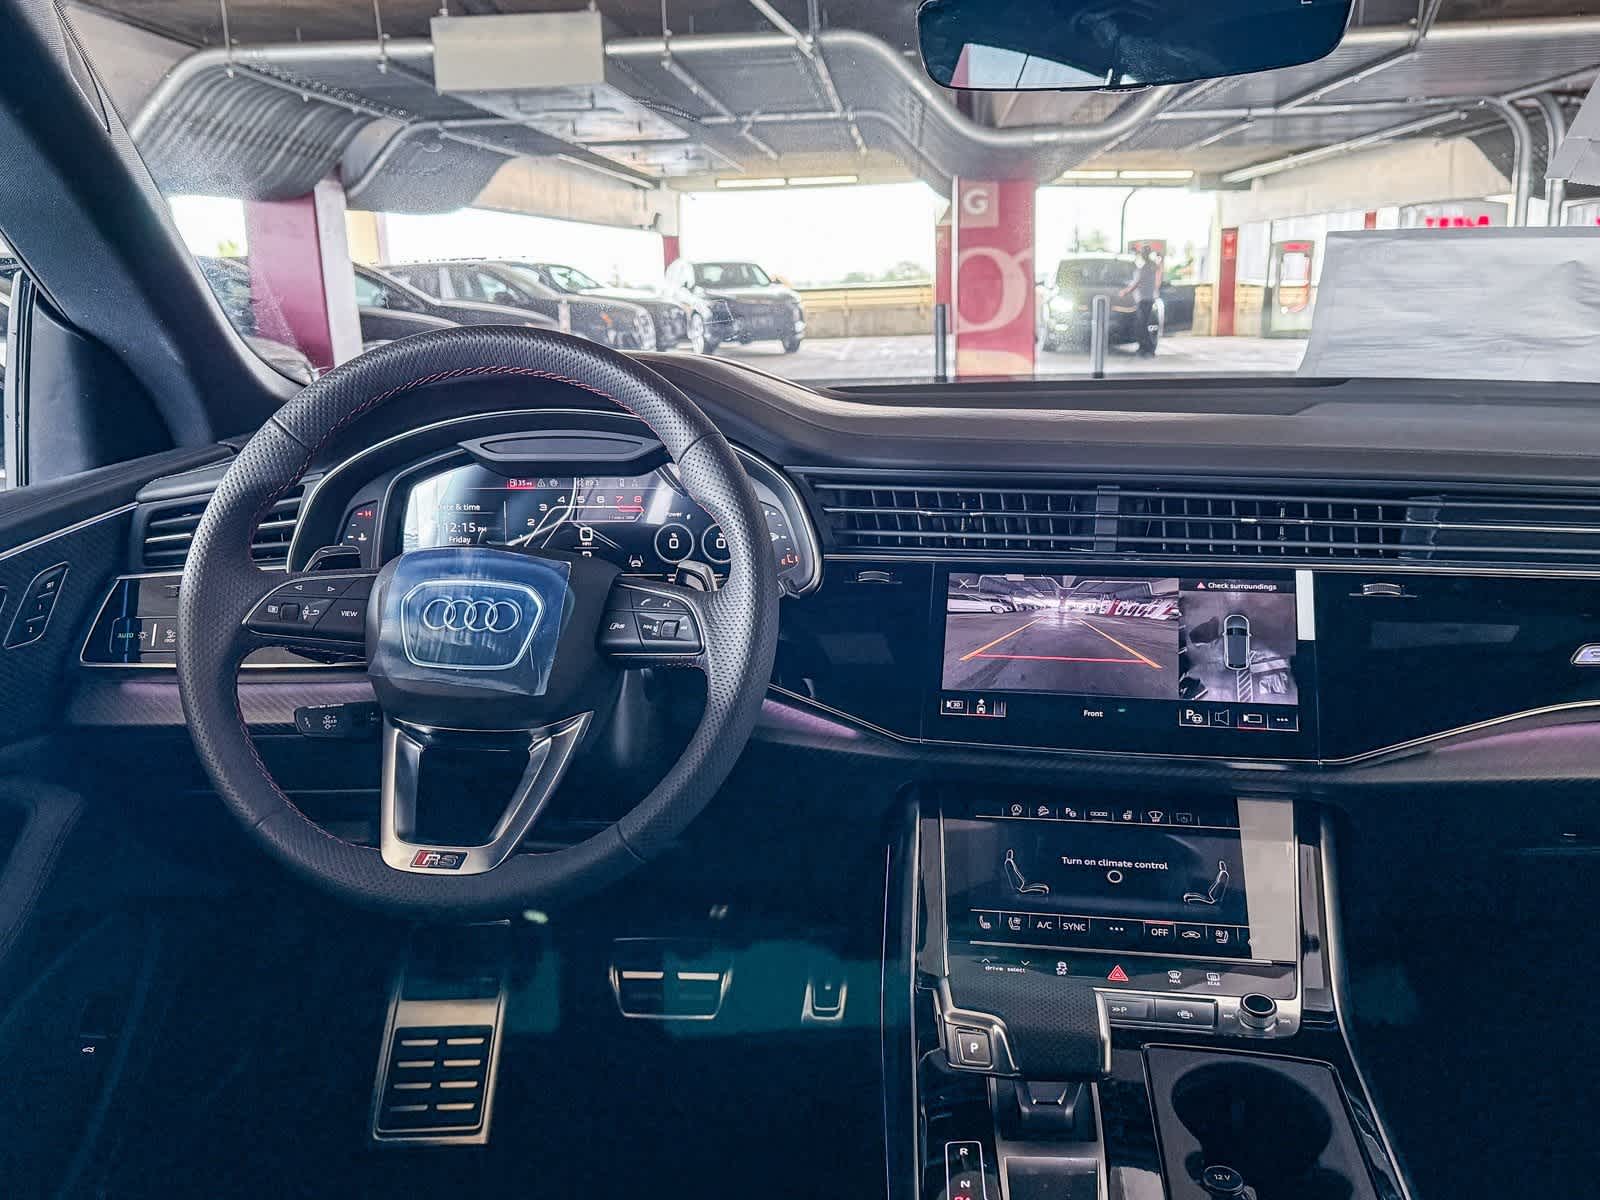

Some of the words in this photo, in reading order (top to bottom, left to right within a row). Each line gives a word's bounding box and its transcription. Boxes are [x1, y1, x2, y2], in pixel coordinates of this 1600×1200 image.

[962, 188, 989, 215] G
[538, 503, 548, 511] 3
[576, 495, 586, 504] 5
[596, 495, 605, 504] 6
[615, 495, 624, 504] 7
[633, 495, 642, 504] 8
[448, 536, 471, 545] Friday
[1230, 583, 1277, 591] surroundings
[1083, 709, 1104, 718] Front
[1061, 856, 1083, 865] Turn
[1084, 858, 1096, 866] on
[1098, 858, 1133, 868] climate
[1134, 861, 1169, 870] control
[1036, 921, 1053, 930] A/C
[1062, 922, 1087, 931] SYNC
[1151, 928, 1169, 937] OFF
[970, 1042, 979, 1054] P
[959, 1147, 969, 1156] R
[960, 1180, 971, 1188] N
